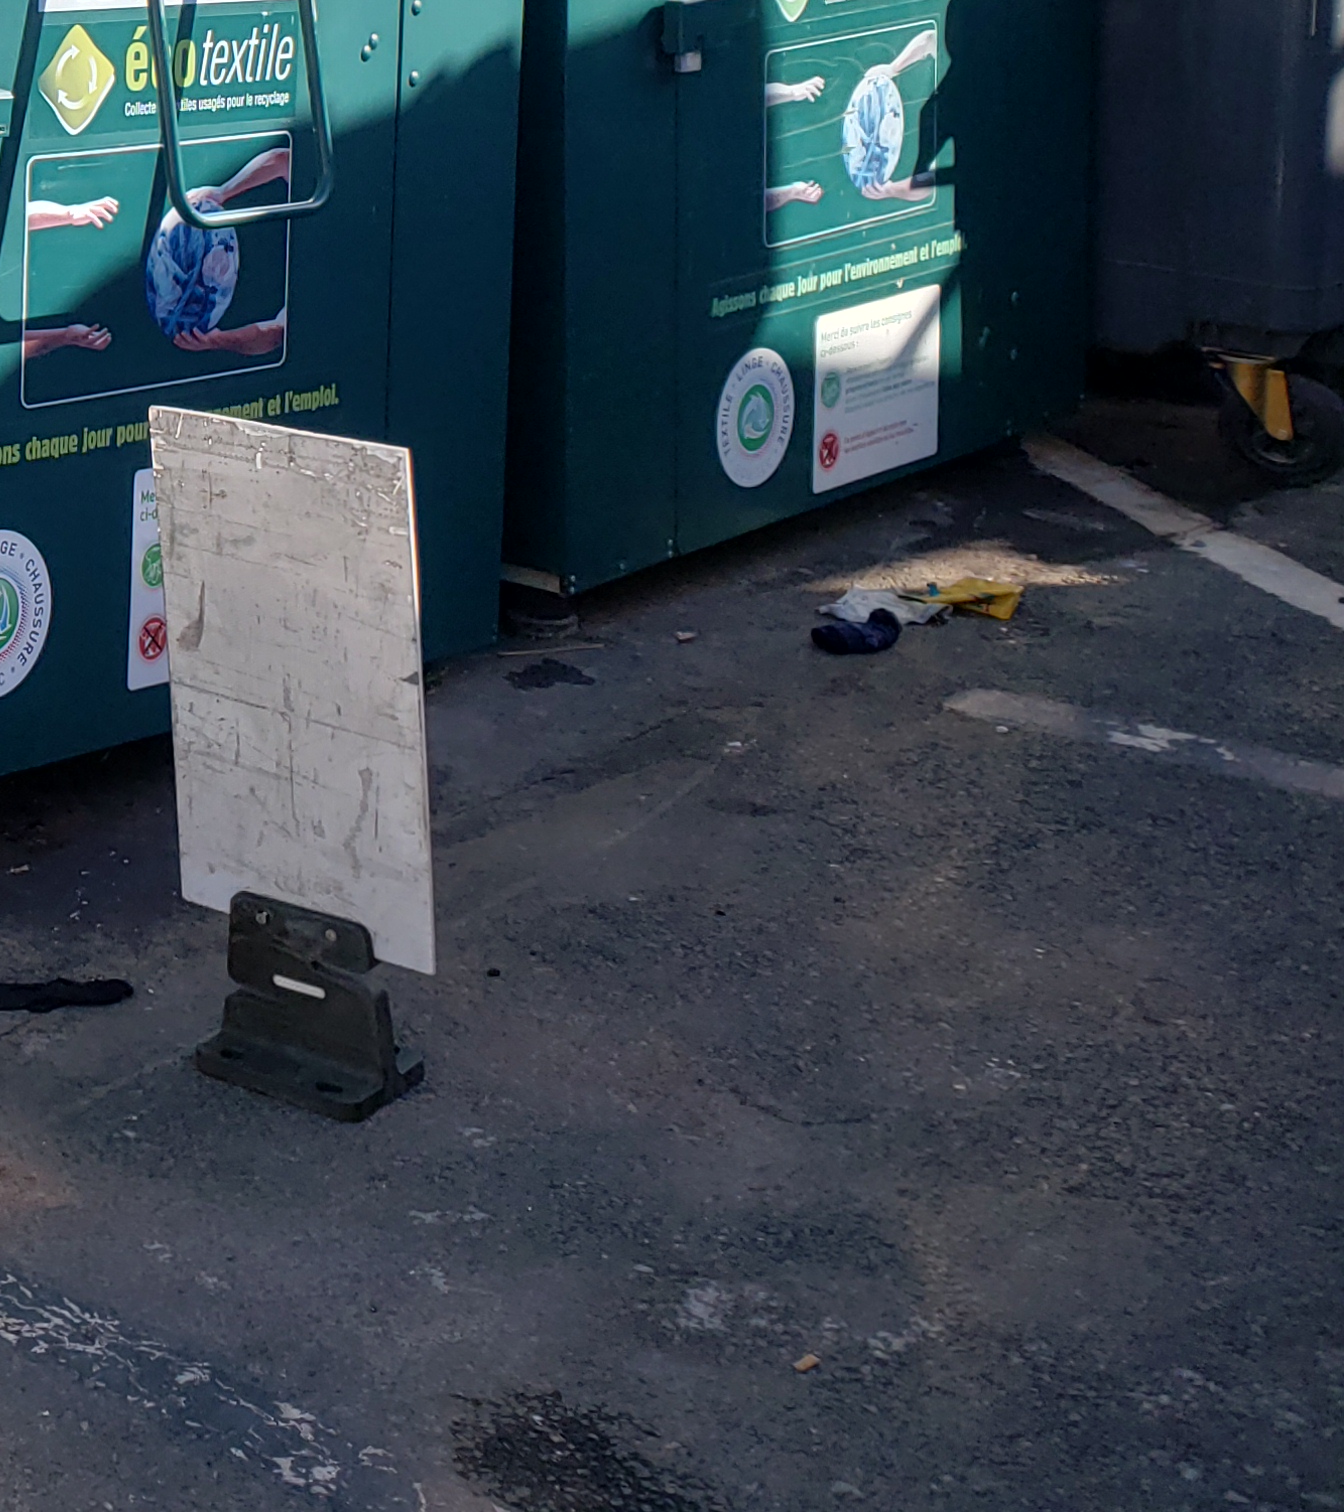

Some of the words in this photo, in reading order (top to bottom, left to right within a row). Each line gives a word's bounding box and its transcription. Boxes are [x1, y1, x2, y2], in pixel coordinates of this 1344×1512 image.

[267, 394, 281, 416] et
[25, 434, 77, 461] chaque
[82, 427, 112, 453] jour
[17, 559, 44, 667] CHAUSSURE
